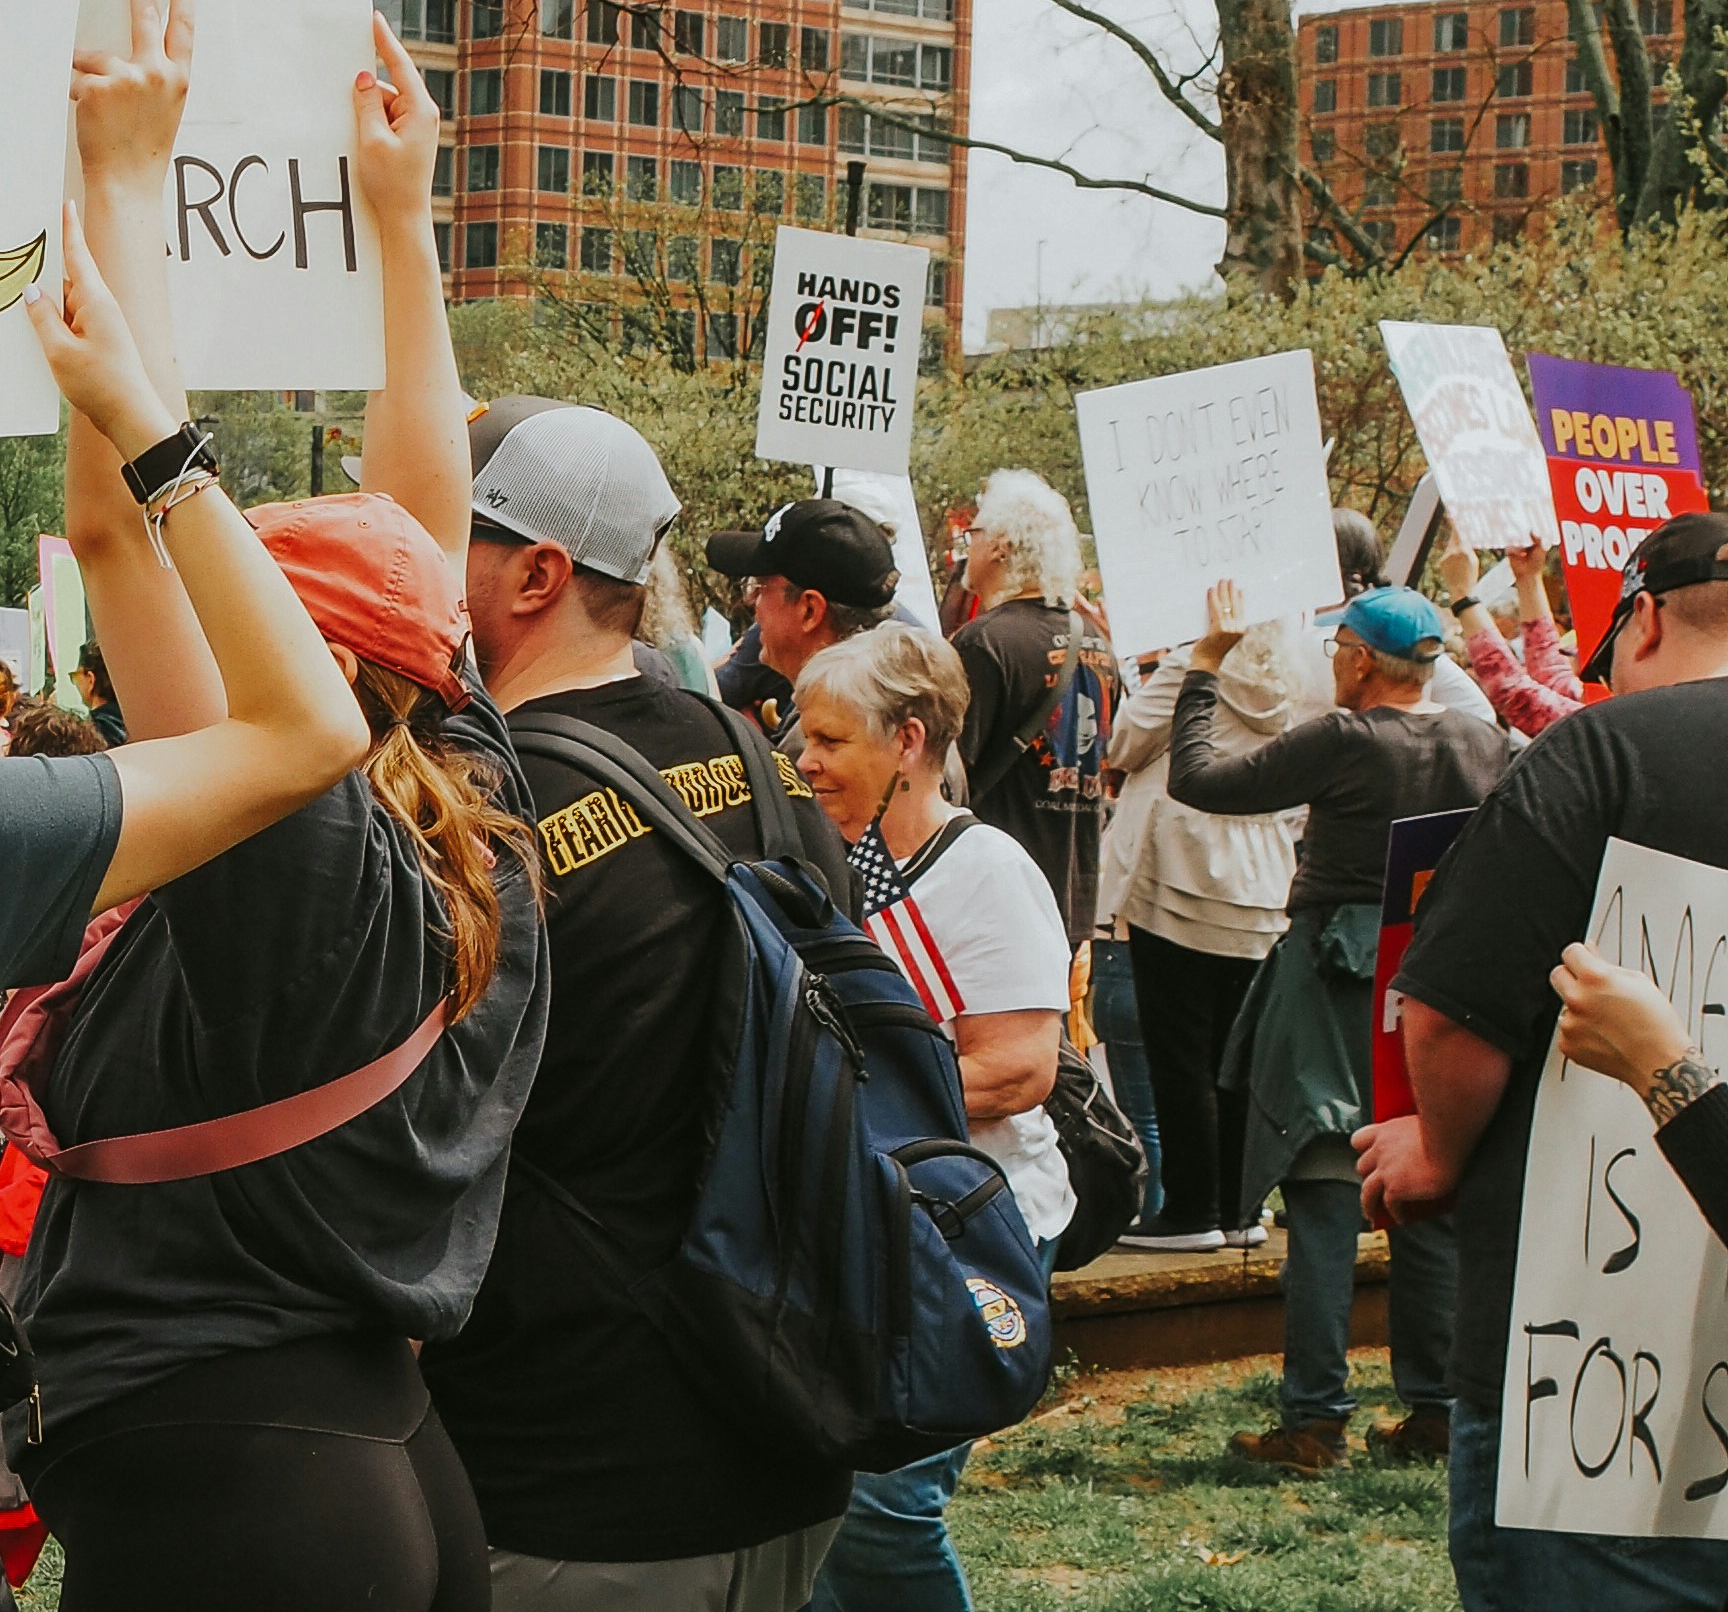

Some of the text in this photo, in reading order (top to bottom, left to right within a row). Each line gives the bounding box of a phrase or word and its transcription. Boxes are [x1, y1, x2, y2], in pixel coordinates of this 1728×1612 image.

[166, 155, 358, 272] RCH
[797, 272, 901, 309] HANDS
[795, 302, 899, 353] OFF!
[782, 354, 897, 404] SOCIAL
[779, 393, 896, 433] SECURITY
[1109, 420, 1125, 472] I
[1228, 384, 1290, 446] EVEN
[1551, 408, 1680, 464] PEOPLE
[1574, 467, 1673, 519] OVER
[1585, 1134, 1642, 1274] IS
[1523, 1319, 1662, 1485] FOR
